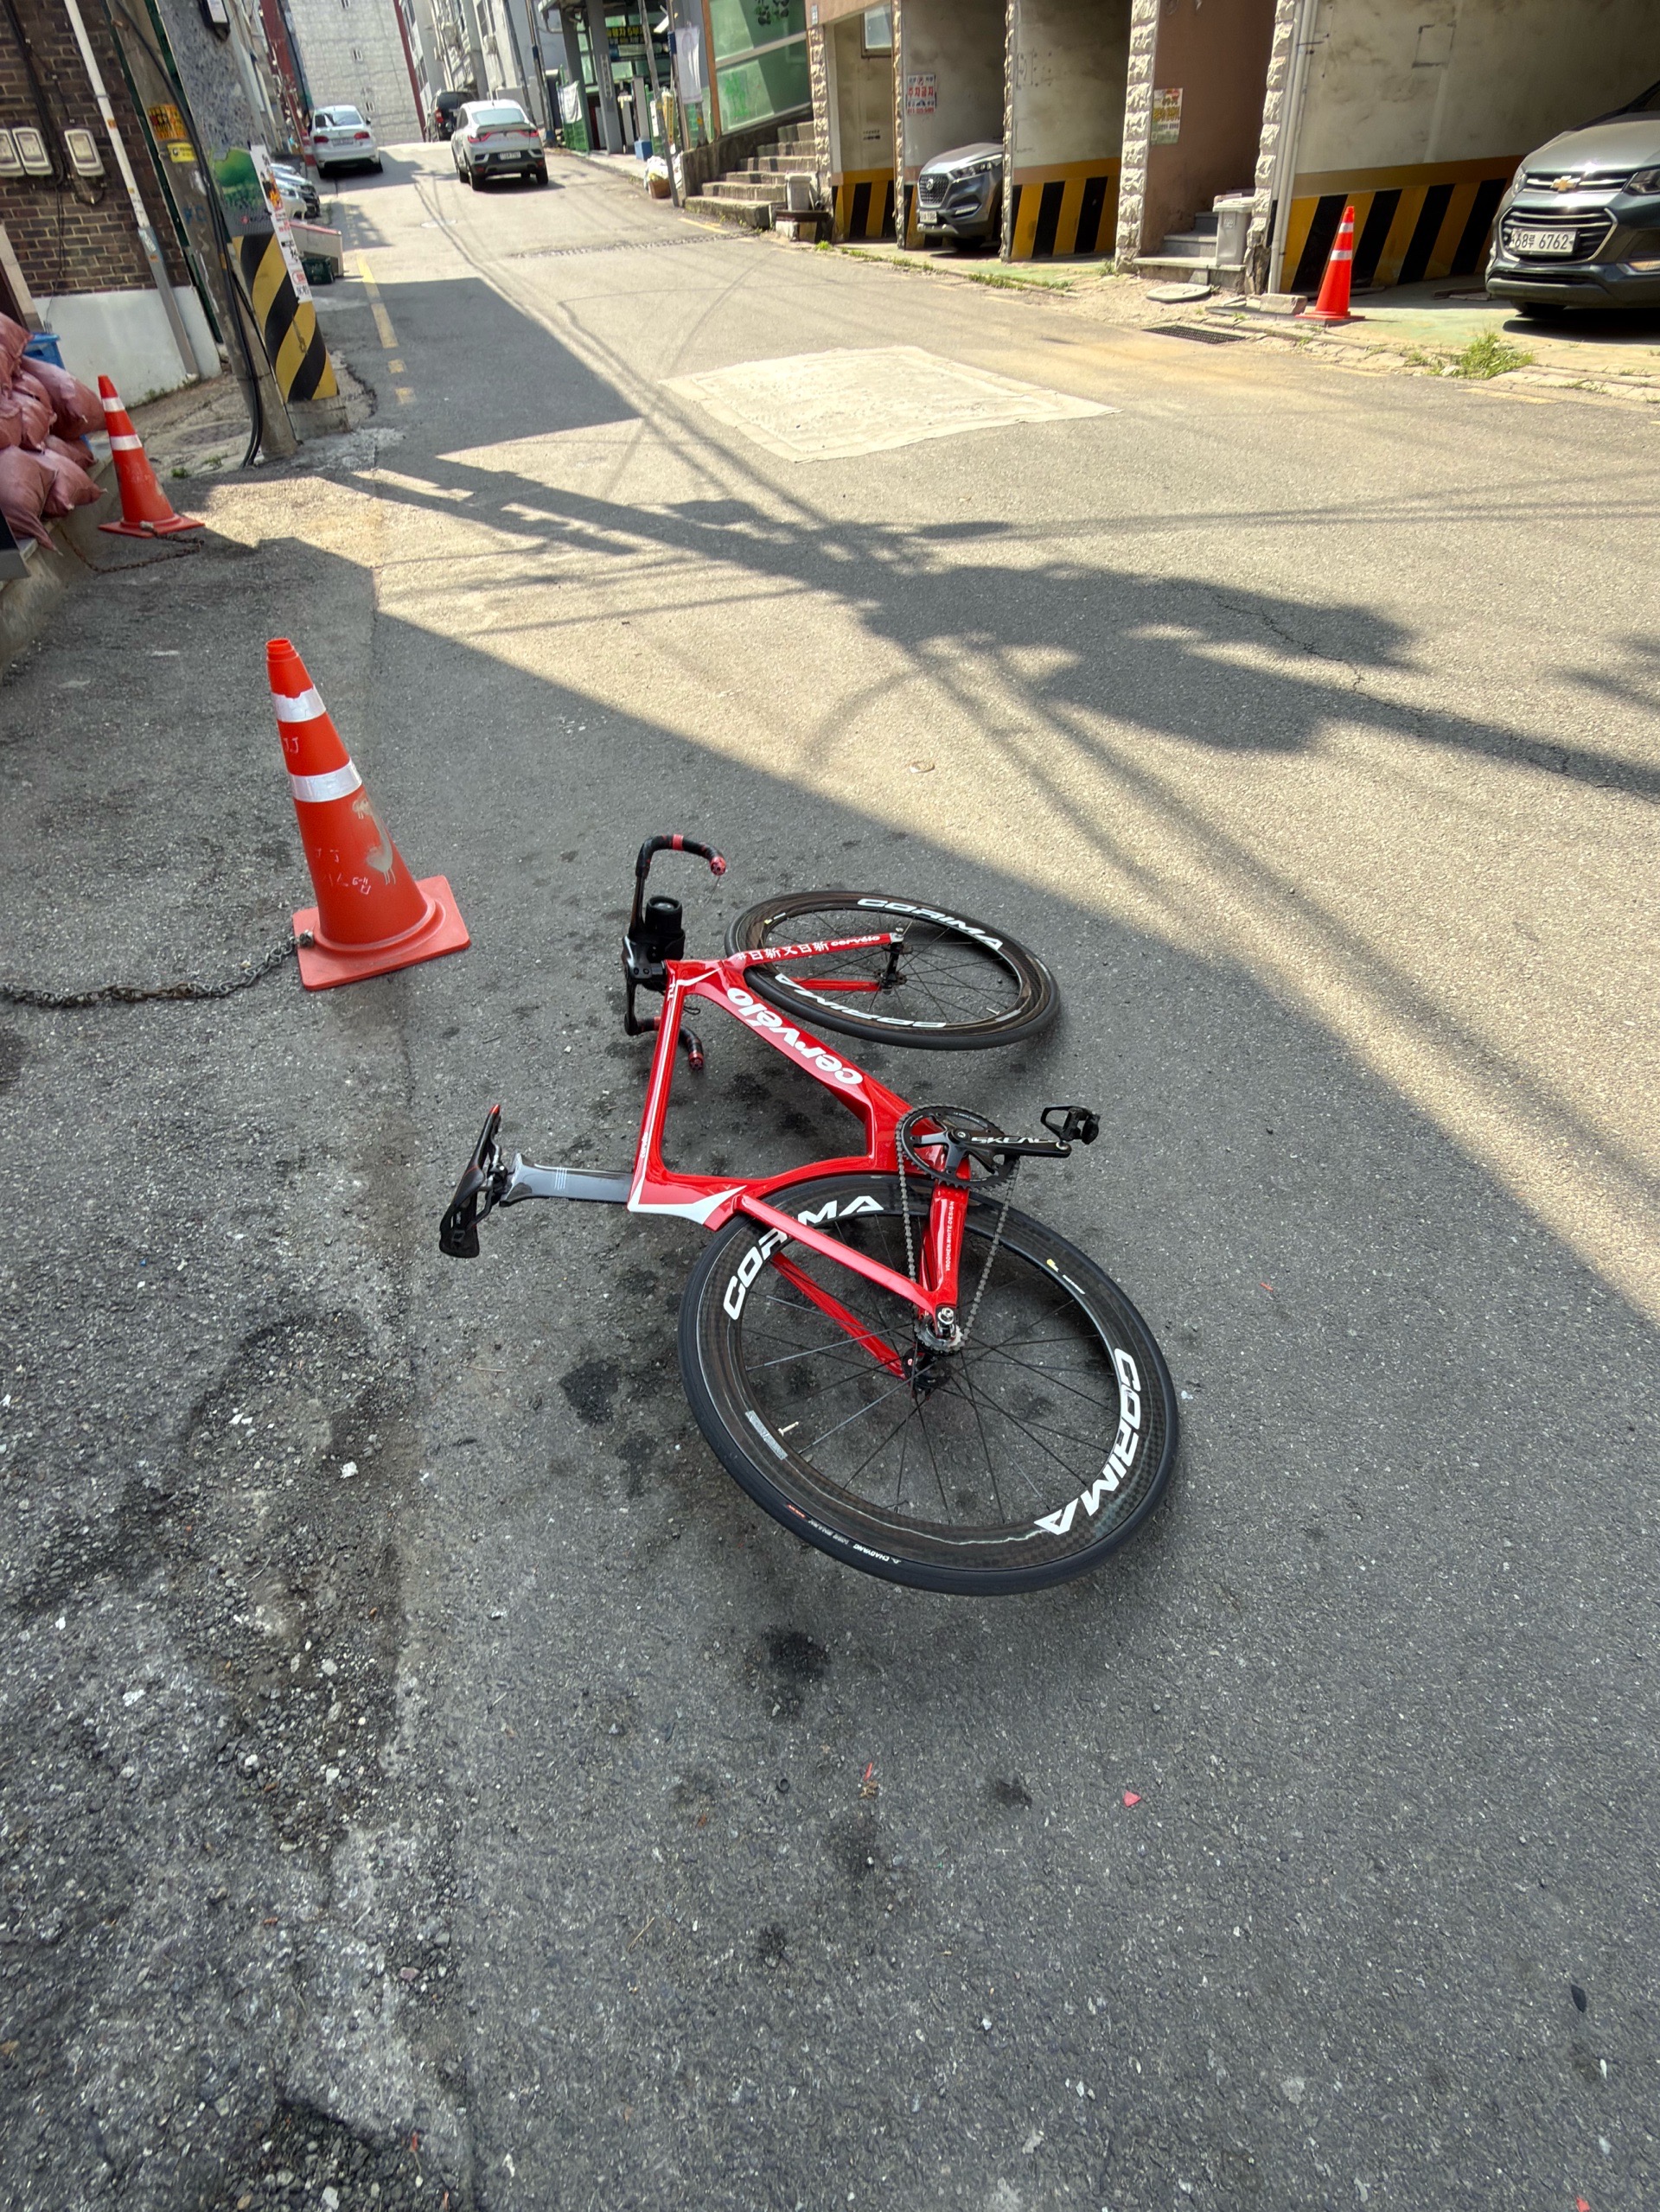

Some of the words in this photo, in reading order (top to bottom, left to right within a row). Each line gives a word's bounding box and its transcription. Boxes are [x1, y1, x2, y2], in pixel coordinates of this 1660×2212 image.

[908, 86, 934, 97] 주차금지
[1515, 233, 1536, 249] 68루
[1538, 233, 1569, 250] 6762
[857, 898, 1004, 951] CORIMA
[775, 973, 947, 1029] CORIMA
[727, 987, 863, 1085] cervélo
[723, 1195, 884, 1320] CORMA
[1034, 1348, 1141, 1535] CORIMA
[852, 1543, 891, 1562] CHAOYANG
